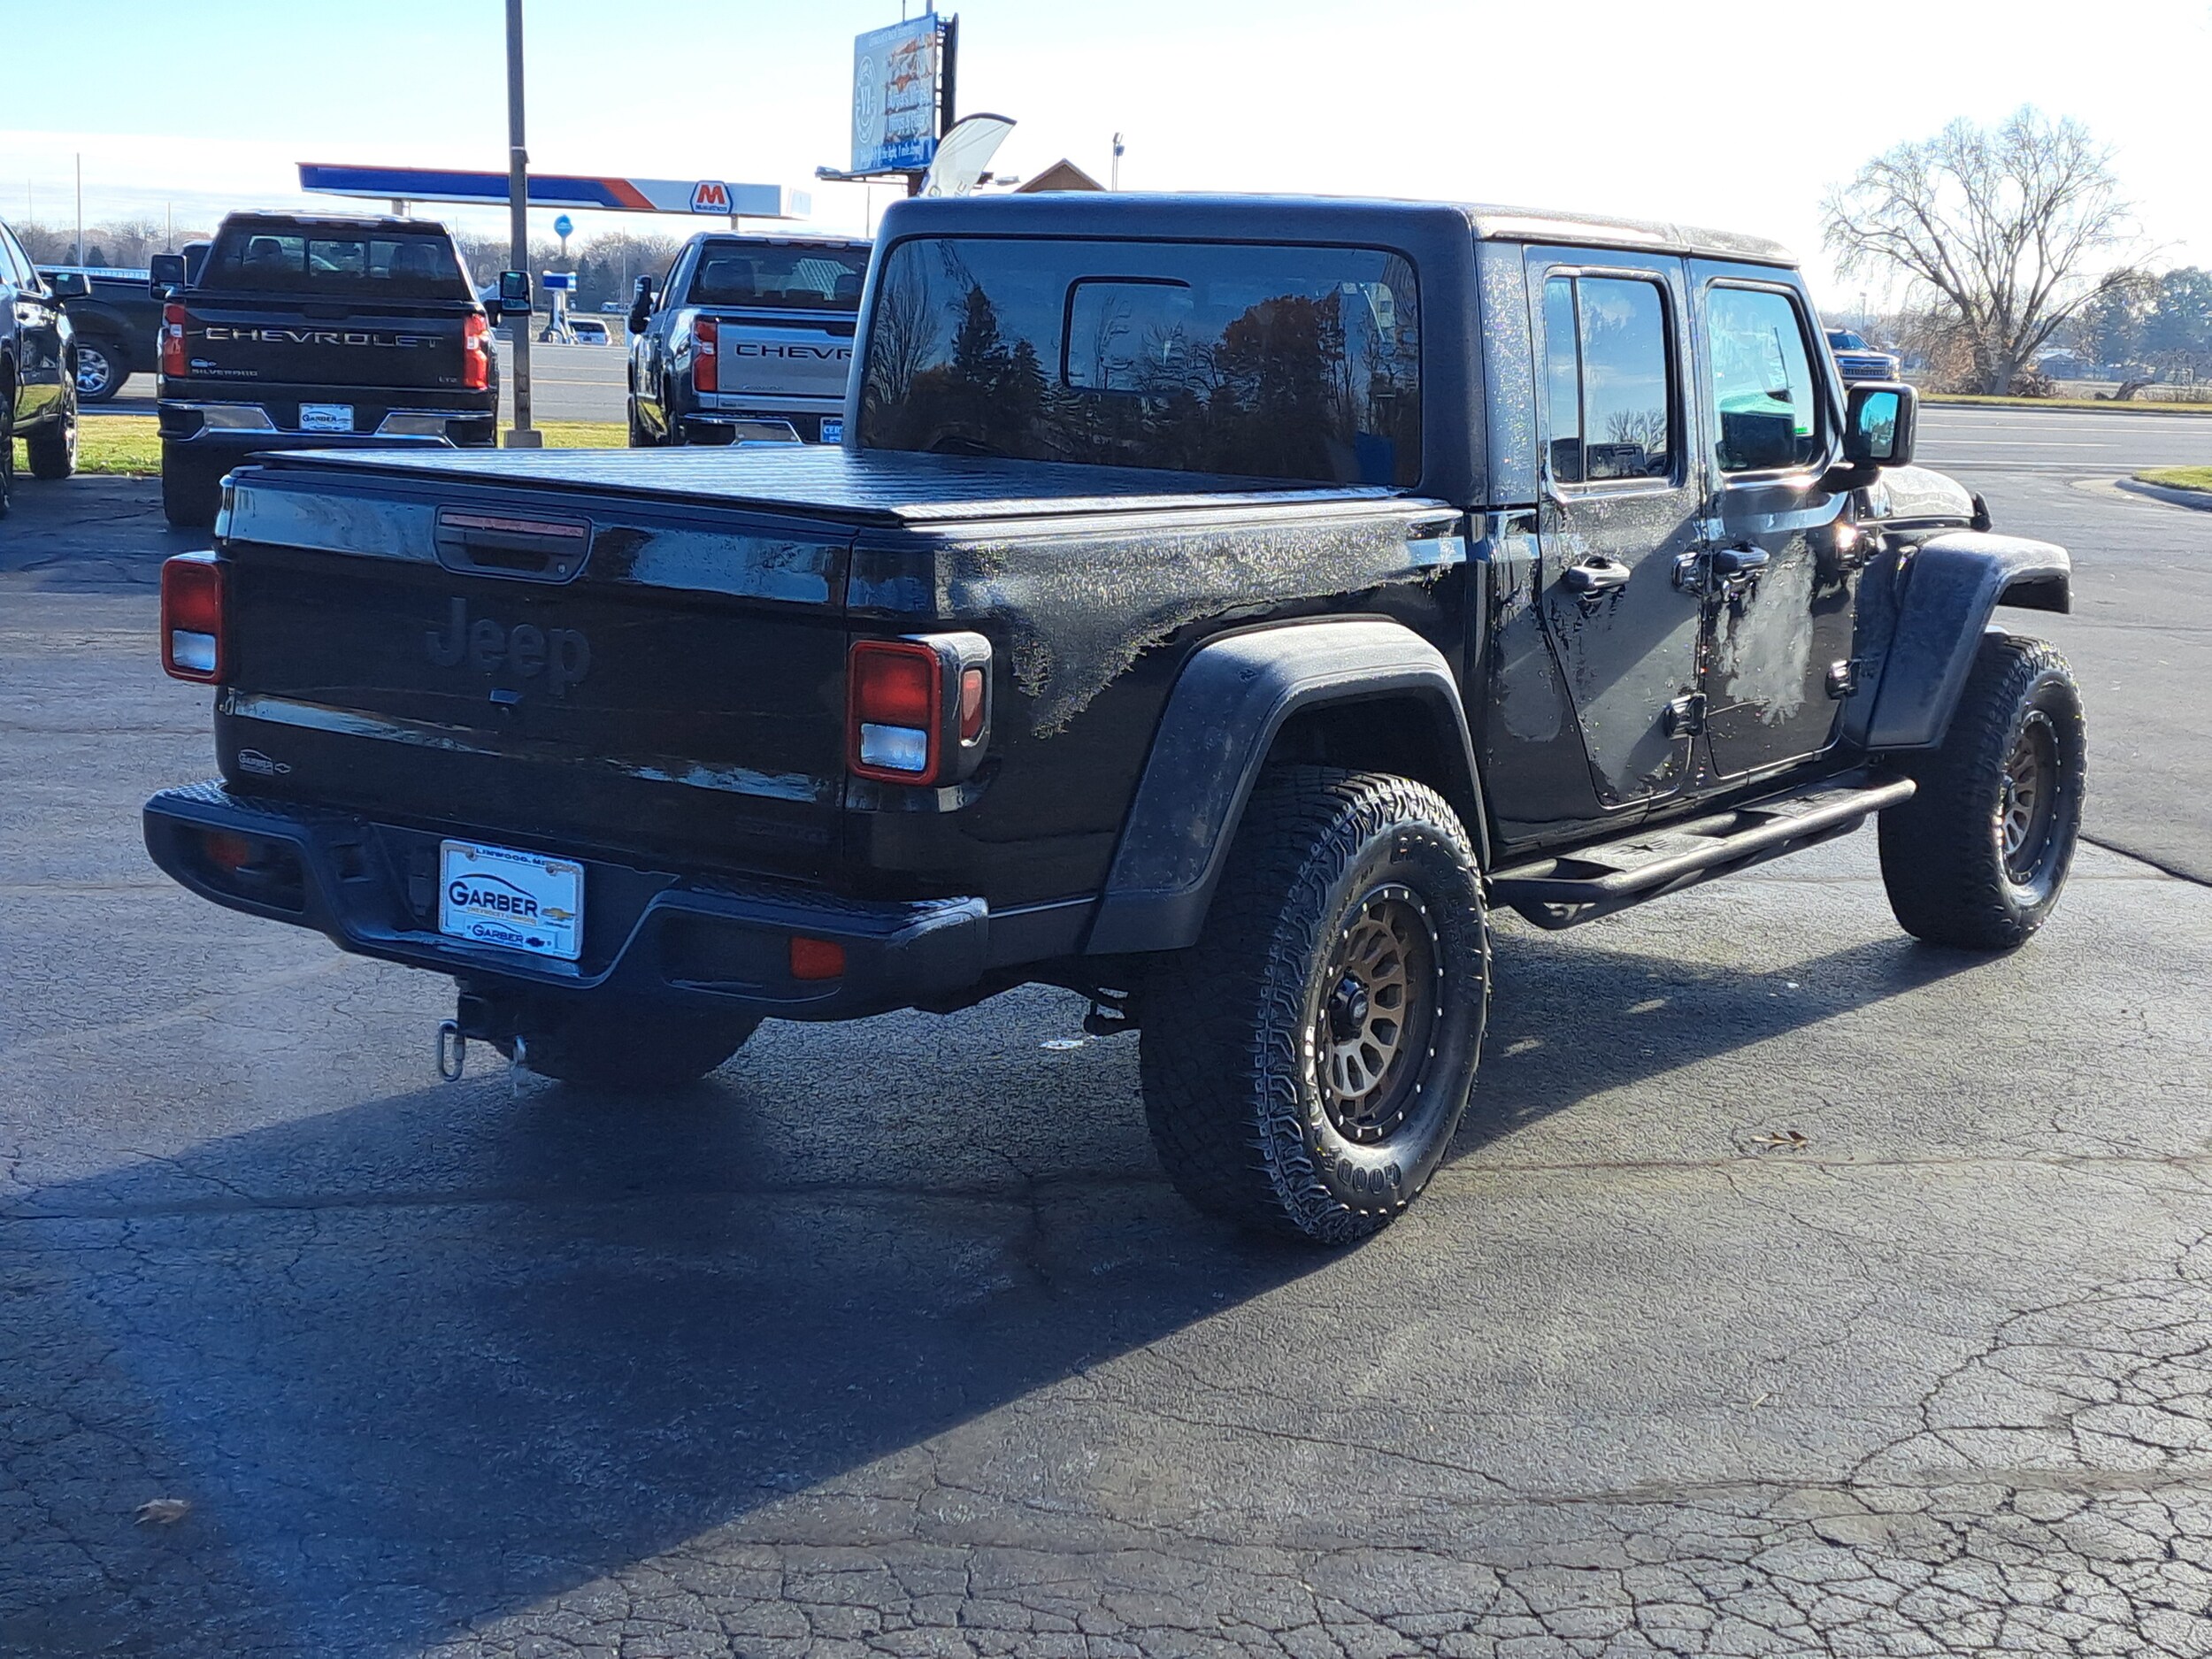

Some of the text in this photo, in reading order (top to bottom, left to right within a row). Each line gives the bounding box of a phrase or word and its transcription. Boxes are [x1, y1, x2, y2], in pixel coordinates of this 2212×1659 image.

[697, 184, 726, 204] M
[206, 326, 443, 349] CHEVROLET
[425, 596, 591, 695] Jeep
[449, 880, 538, 918] GARBER
[472, 924, 525, 944] GARBER
